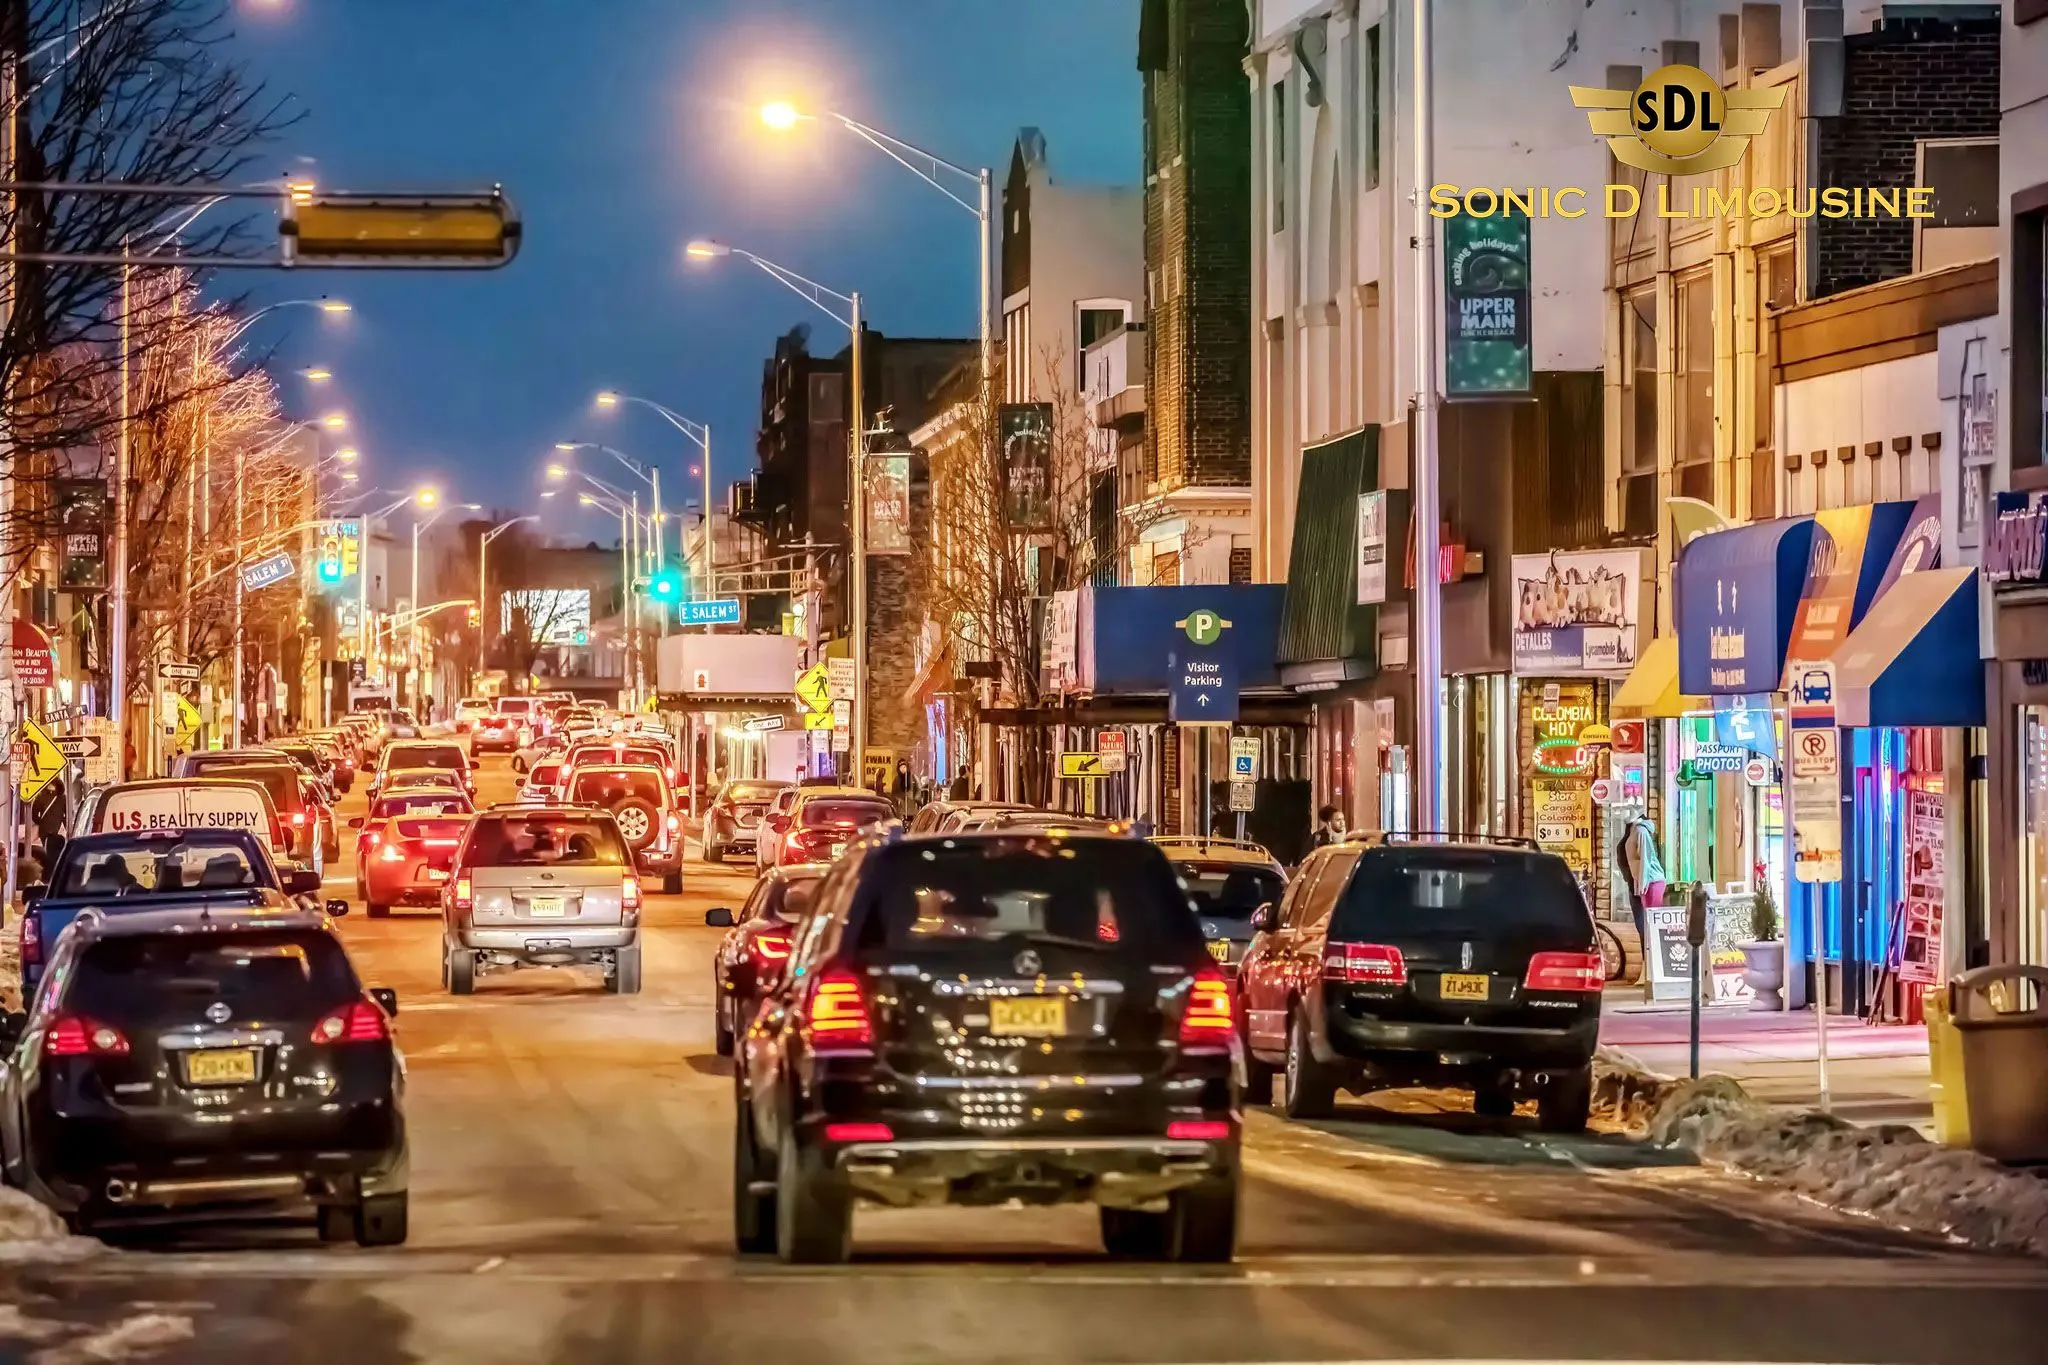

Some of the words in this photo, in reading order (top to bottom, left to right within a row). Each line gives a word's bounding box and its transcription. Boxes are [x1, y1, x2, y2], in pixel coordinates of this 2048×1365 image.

[1460, 298, 1517, 314] UPPER
[1461, 314, 1517, 329] MAIN
[67, 534, 98, 544] UPPER
[67, 543, 98, 552] MAIN
[245, 564, 279, 586] SALEM
[692, 605, 727, 619] SALEM
[728, 605, 737, 614] ST
[1196, 614, 1213, 640] P
[1515, 632, 1552, 651] DETALLES
[1187, 663, 1219, 672] Visitor
[1184, 676, 1222, 687] Parking
[44, 709, 69, 723] BANTA
[1533, 705, 1593, 721] COLOMBIA
[1549, 722, 1576, 736] HOY
[13, 744, 23, 752] NO
[62, 743, 80, 752] WAY
[1696, 744, 1740, 754] PASSPORT
[1696, 757, 1741, 770] PHOTOS
[1549, 790, 1577, 801] Store
[112, 811, 147, 830] U.S.
[150, 812, 204, 829] BEAUTY
[208, 812, 258, 827] SUPPLY
[1539, 813, 1586, 821] Colombia
